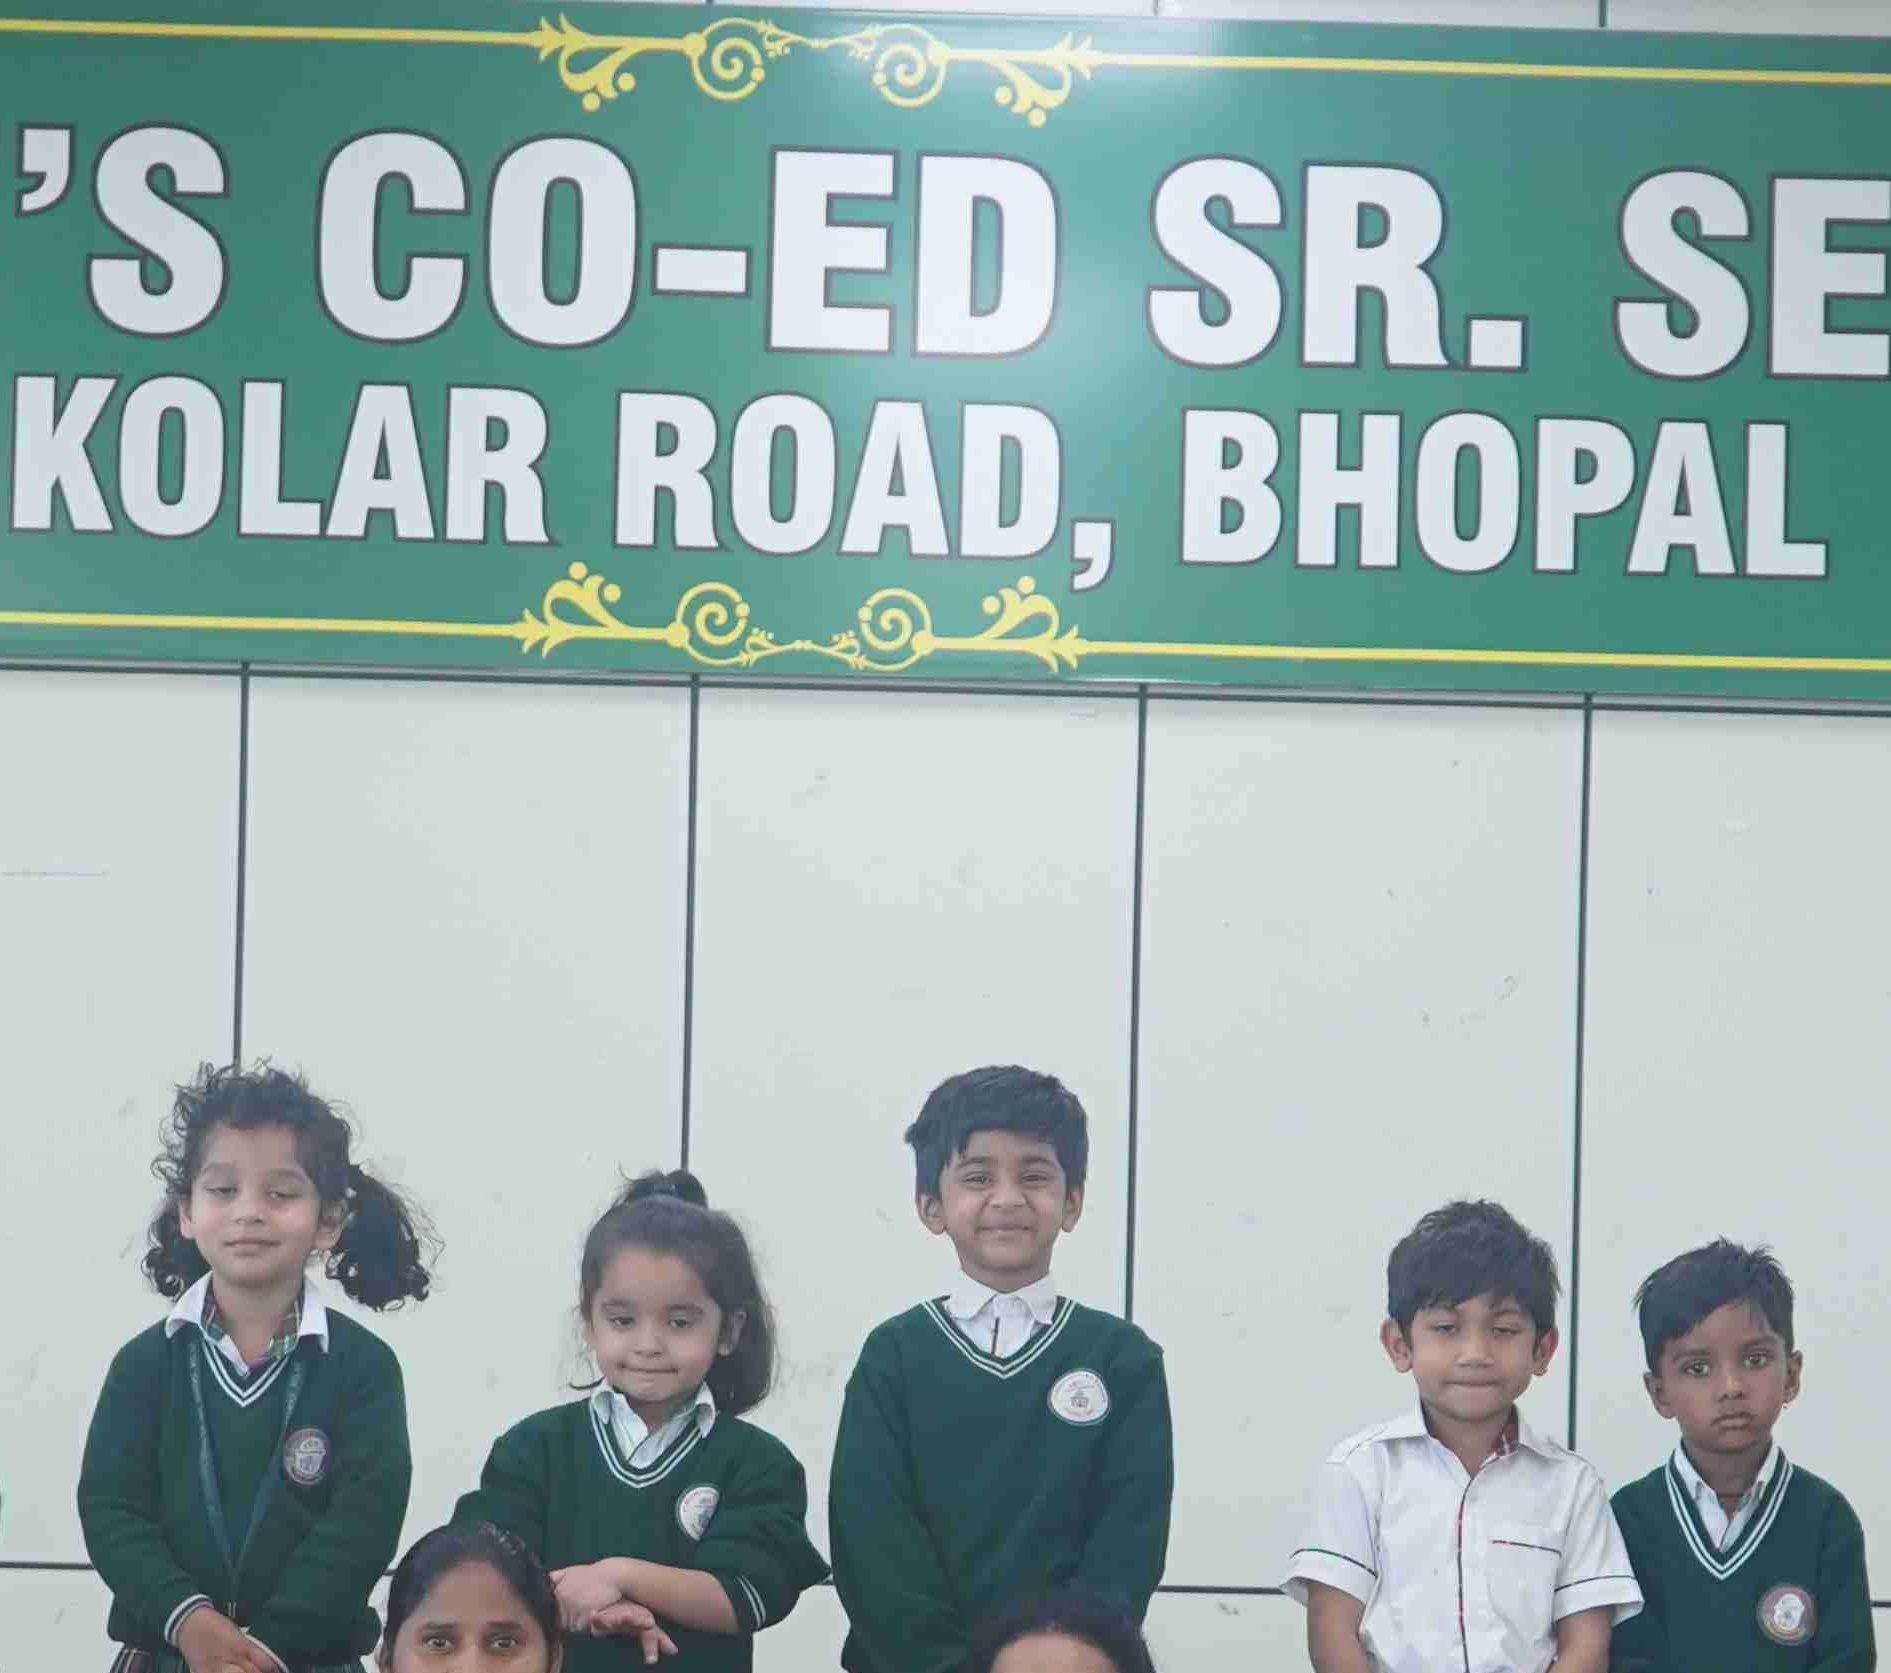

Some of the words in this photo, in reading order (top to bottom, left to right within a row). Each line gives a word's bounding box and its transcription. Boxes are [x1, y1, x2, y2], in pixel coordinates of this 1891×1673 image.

[319, 132, 1060, 357] CO-ED
[1147, 157, 1524, 370] SR.
[12, 375, 550, 545] KOLAR
[615, 391, 1114, 592] ROAD,
[1181, 408, 1827, 577] BHOPAL
